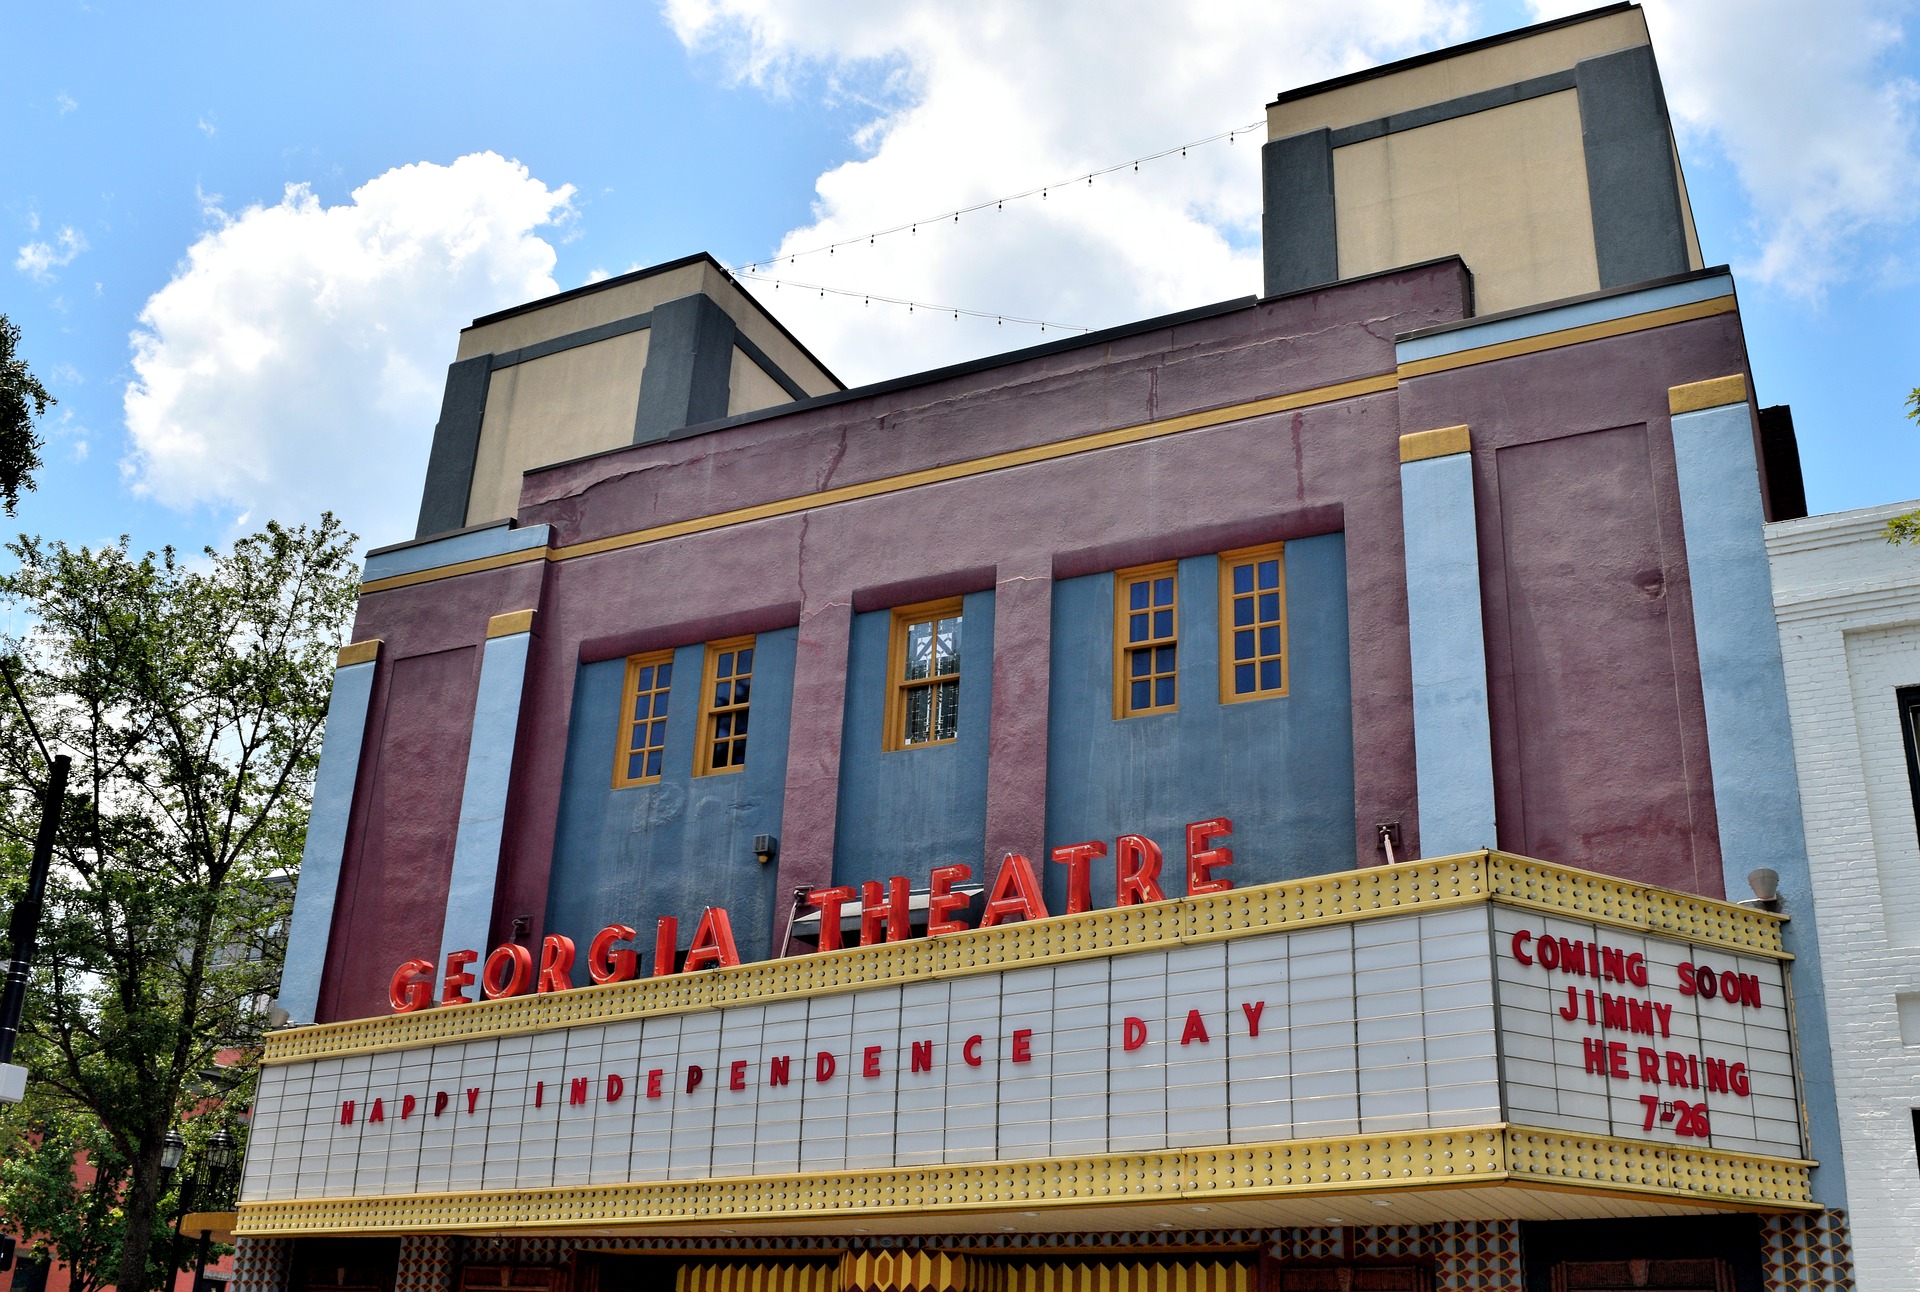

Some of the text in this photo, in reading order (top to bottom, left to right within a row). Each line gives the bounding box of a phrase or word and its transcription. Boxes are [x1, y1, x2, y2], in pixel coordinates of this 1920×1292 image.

[389, 816, 1234, 1013] GEORGIA THEATRE
[1511, 929, 1762, 1009] COMING SOON
[1558, 985, 1673, 1039] JIMMY
[339, 1000, 1265, 1126] HAPPY INDEPENDENCE DAY
[1583, 1036, 1751, 1098] HERRING
[1639, 1094, 1712, 1139] 7-26
